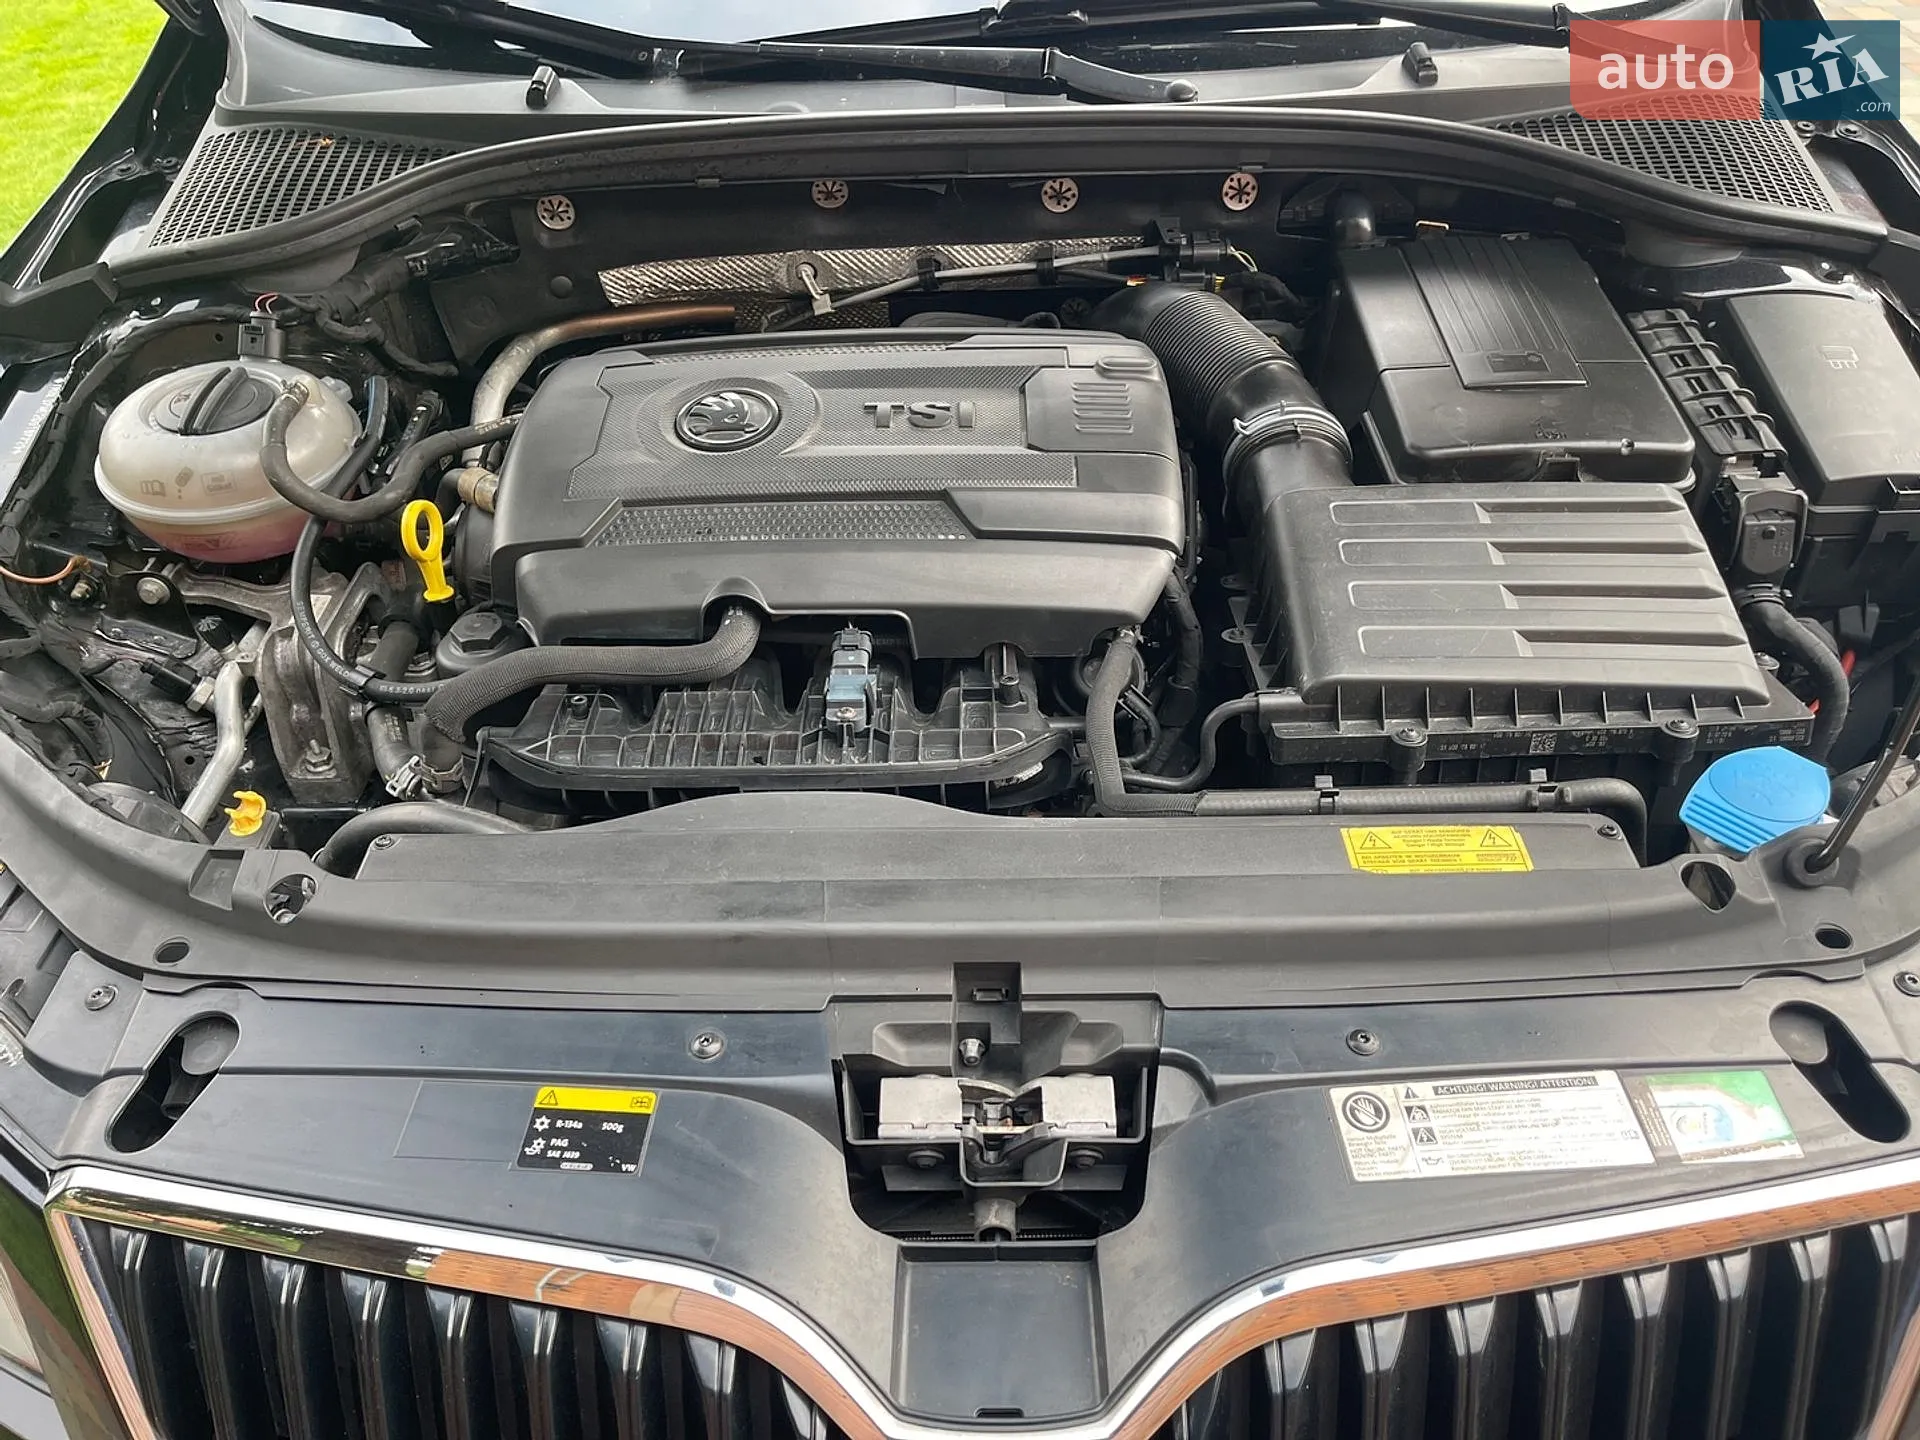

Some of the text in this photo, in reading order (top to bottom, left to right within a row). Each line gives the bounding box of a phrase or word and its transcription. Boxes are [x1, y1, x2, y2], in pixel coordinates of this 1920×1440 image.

[863, 401, 976, 431] TSI
[1437, 1077, 1595, 1096] ACHTUNG! WARNING! ATTENTION!
[602, 1121, 625, 1133] 500g
[550, 1138, 569, 1147] PAG
[546, 1149, 560, 1158] SAE
[621, 1163, 637, 1172] VW
